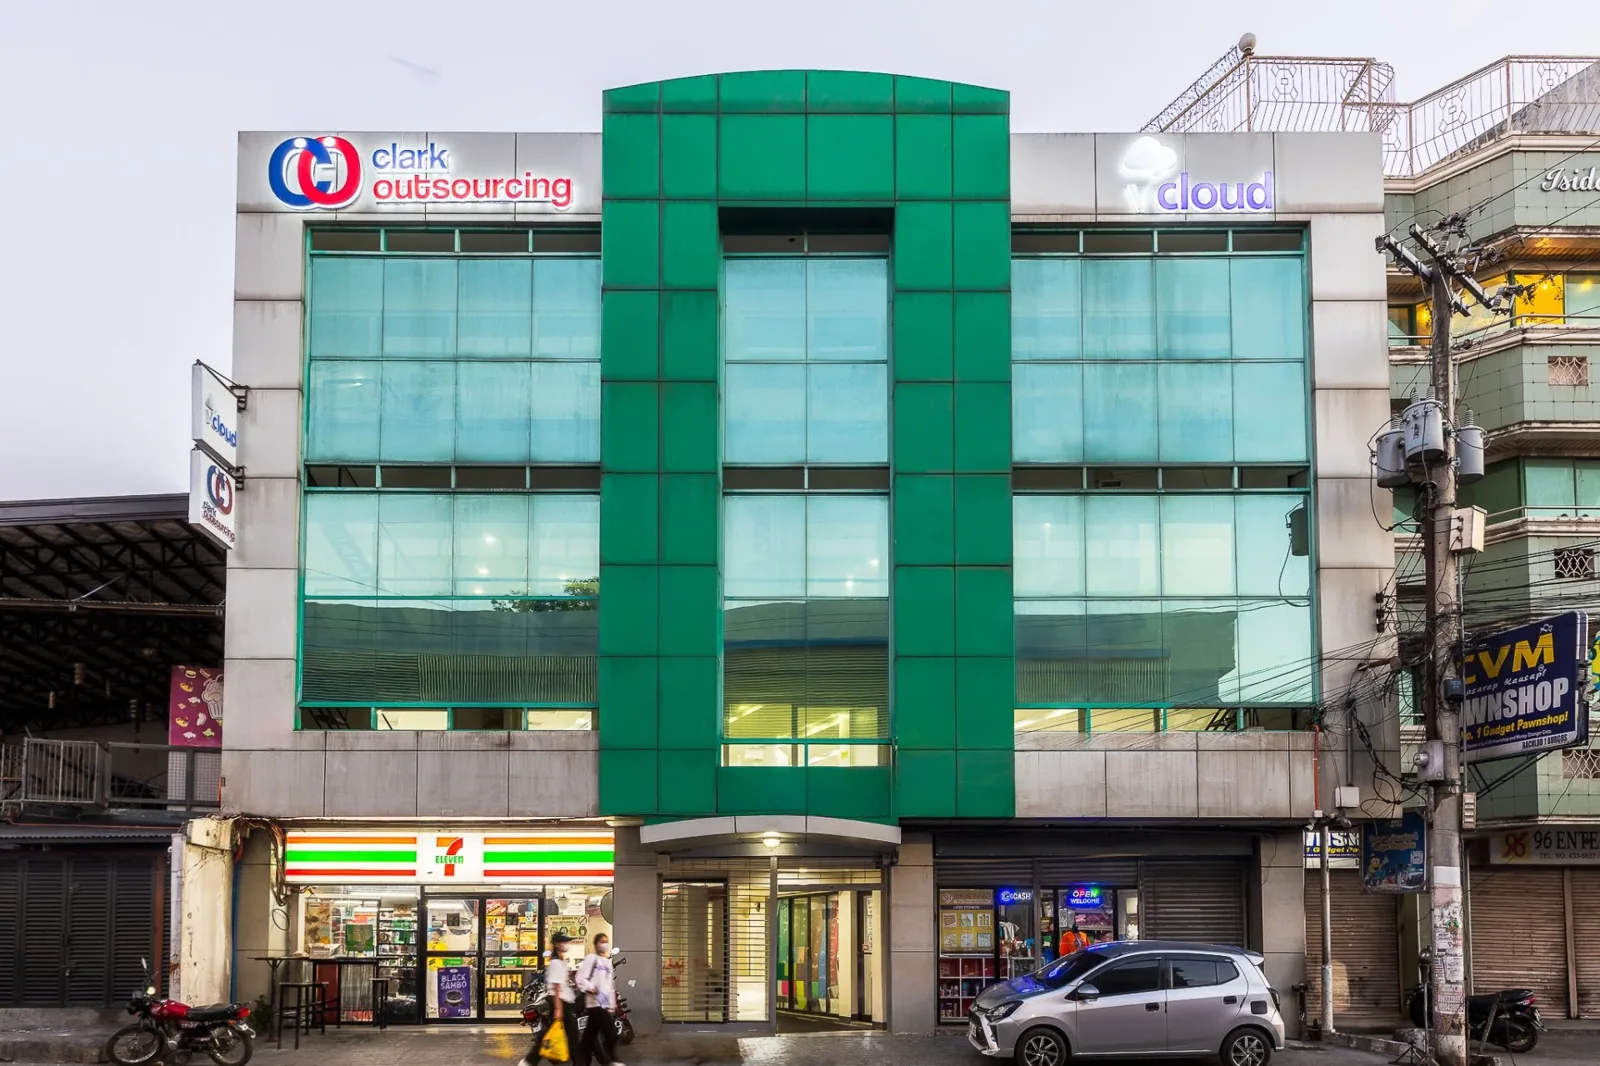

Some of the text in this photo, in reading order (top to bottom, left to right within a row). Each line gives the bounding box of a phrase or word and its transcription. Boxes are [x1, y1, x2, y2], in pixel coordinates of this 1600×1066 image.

[372, 142, 448, 170] clark
[372, 171, 573, 208] outsourcing
[1157, 171, 1272, 210] cloud
[210, 414, 237, 448] cloud
[202, 501, 217, 518] clark
[202, 509, 236, 543] outsourcing
[1476, 726, 1482, 739] 1
[1483, 722, 1515, 738] Gadget
[1517, 710, 1569, 731] Pawnshop!
[1522, 738, 1544, 750] BACOLOD
[1548, 733, 1568, 746] BURGOS
[1533, 830, 1553, 850] 96
[1072, 889, 1098, 898] OPEN
[440, 980, 468, 990] SAMBO
[441, 973, 466, 983] BLACK
